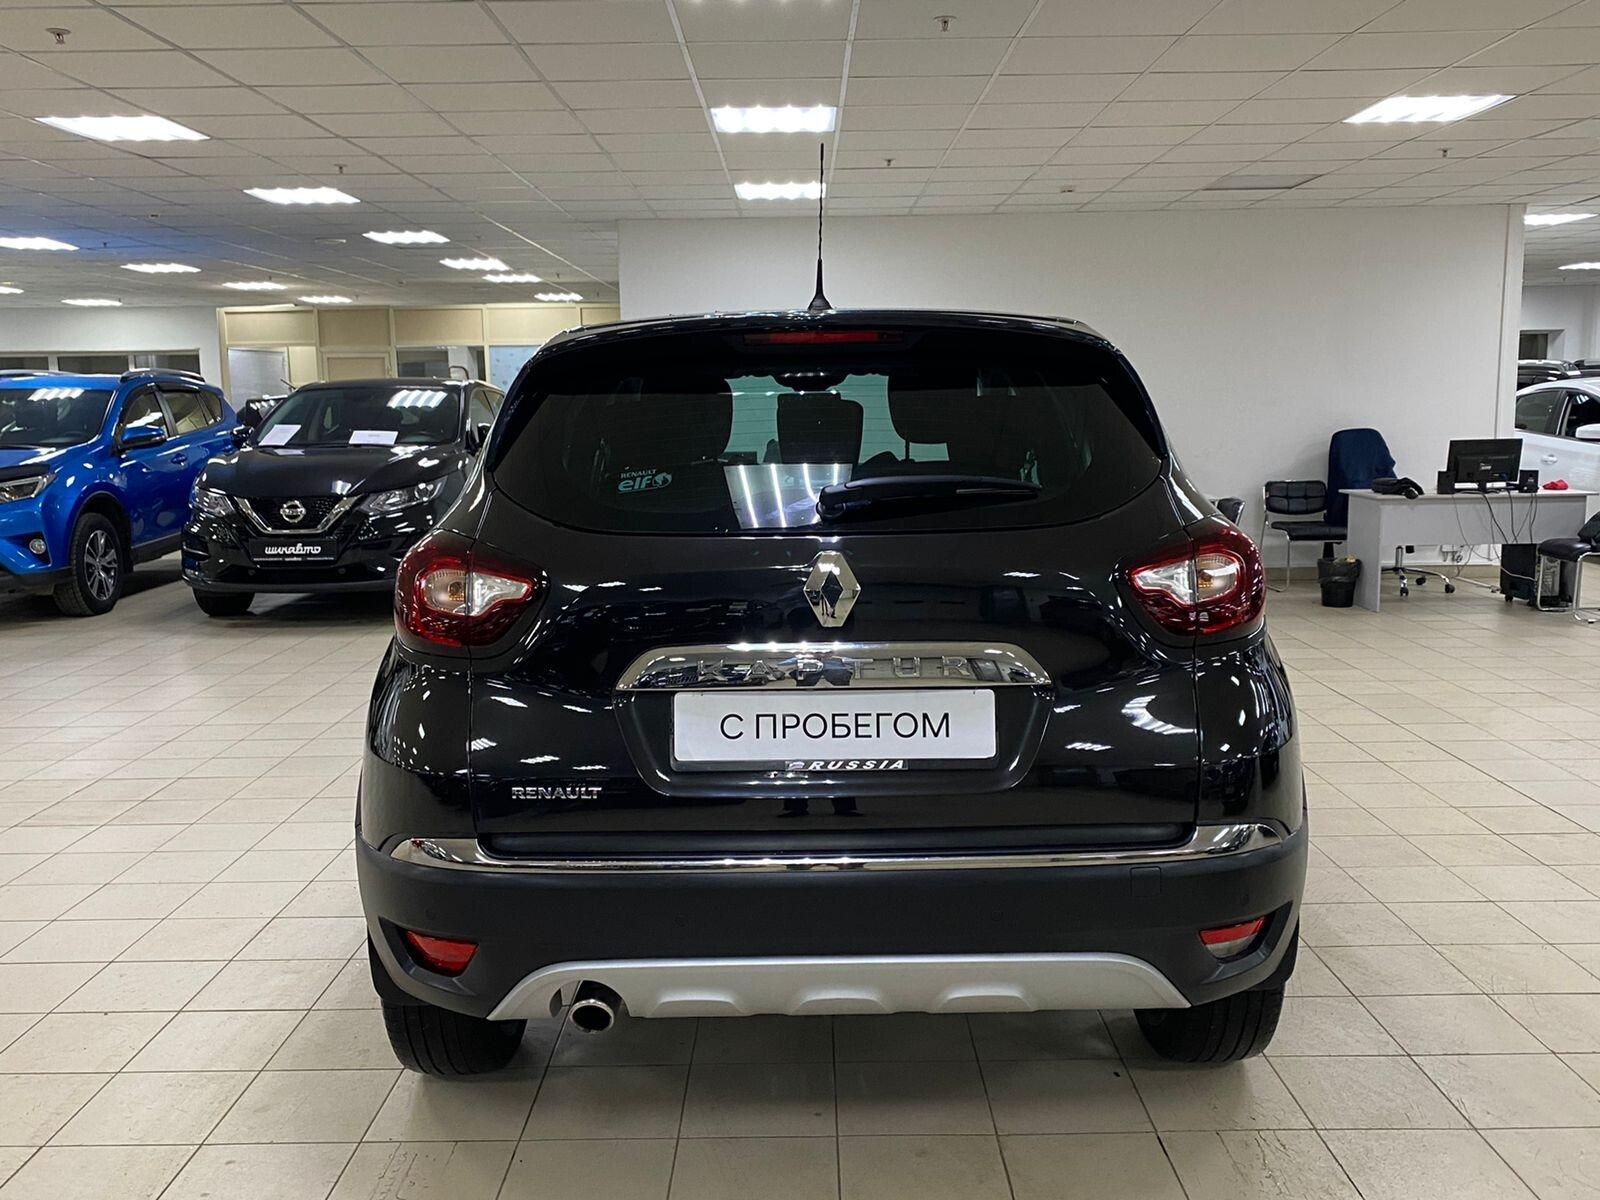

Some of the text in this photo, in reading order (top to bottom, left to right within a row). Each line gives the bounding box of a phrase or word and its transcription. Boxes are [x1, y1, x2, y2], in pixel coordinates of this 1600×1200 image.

[620, 469, 657, 479] RENAULT
[618, 475, 652, 491] elf
[697, 656, 972, 682] KAPTUR
[719, 712, 950, 740] С ПРОБЕГОМ
[808, 759, 905, 771] RUSSIA
[511, 786, 602, 800] RENAULT
